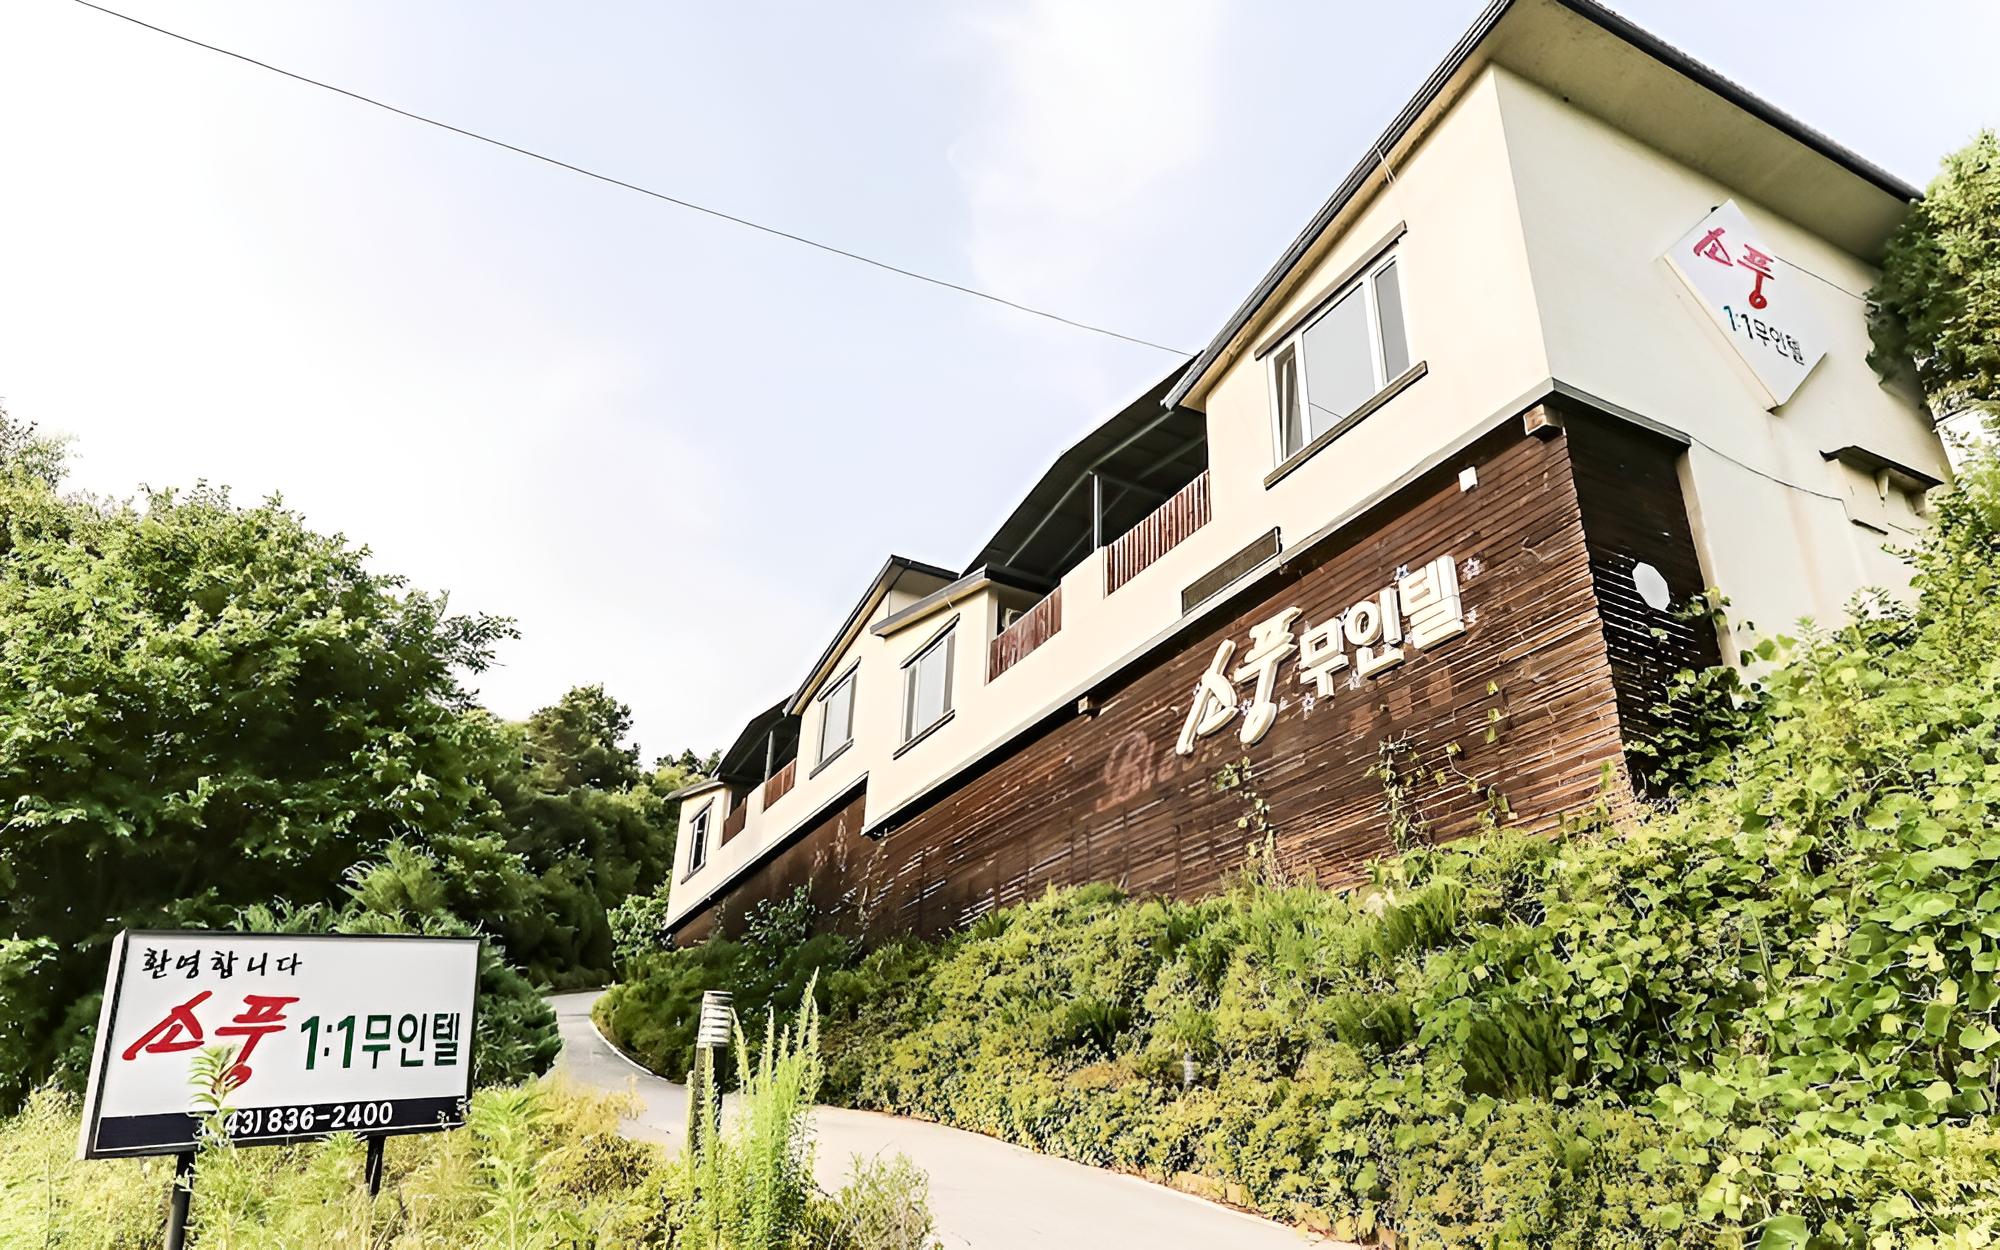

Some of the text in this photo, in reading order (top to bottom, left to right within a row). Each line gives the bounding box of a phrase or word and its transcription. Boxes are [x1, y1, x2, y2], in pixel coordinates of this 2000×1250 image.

[1693, 227, 1775, 310] 소풍
[1175, 554, 1467, 756] 소풍 무인텔
[142, 947, 303, 980] 환영합니다
[122, 990, 461, 1094] 소풍 1:1무인텔
